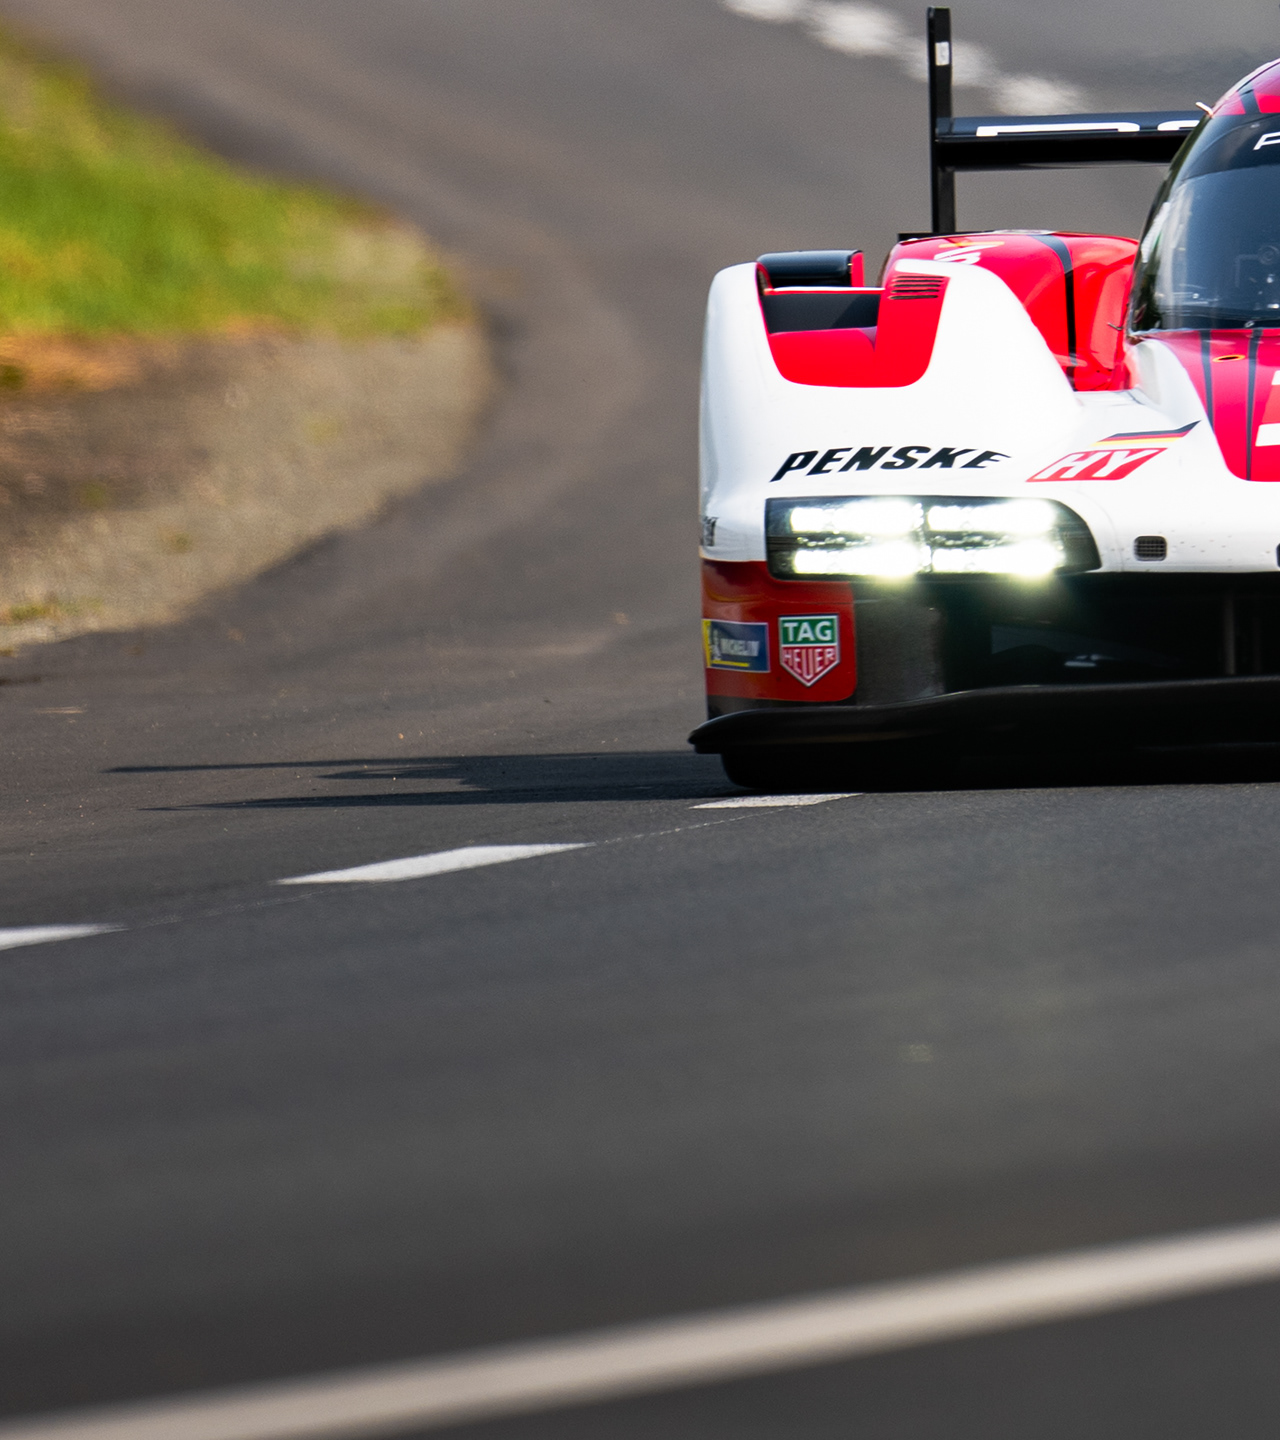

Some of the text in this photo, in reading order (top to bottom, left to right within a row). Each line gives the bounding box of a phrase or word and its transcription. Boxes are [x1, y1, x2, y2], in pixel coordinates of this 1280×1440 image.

[769, 445, 1012, 482] PENSKE
[1031, 449, 1161, 480] HY
[783, 620, 832, 642] TAG
[782, 647, 835, 680] HEUER
